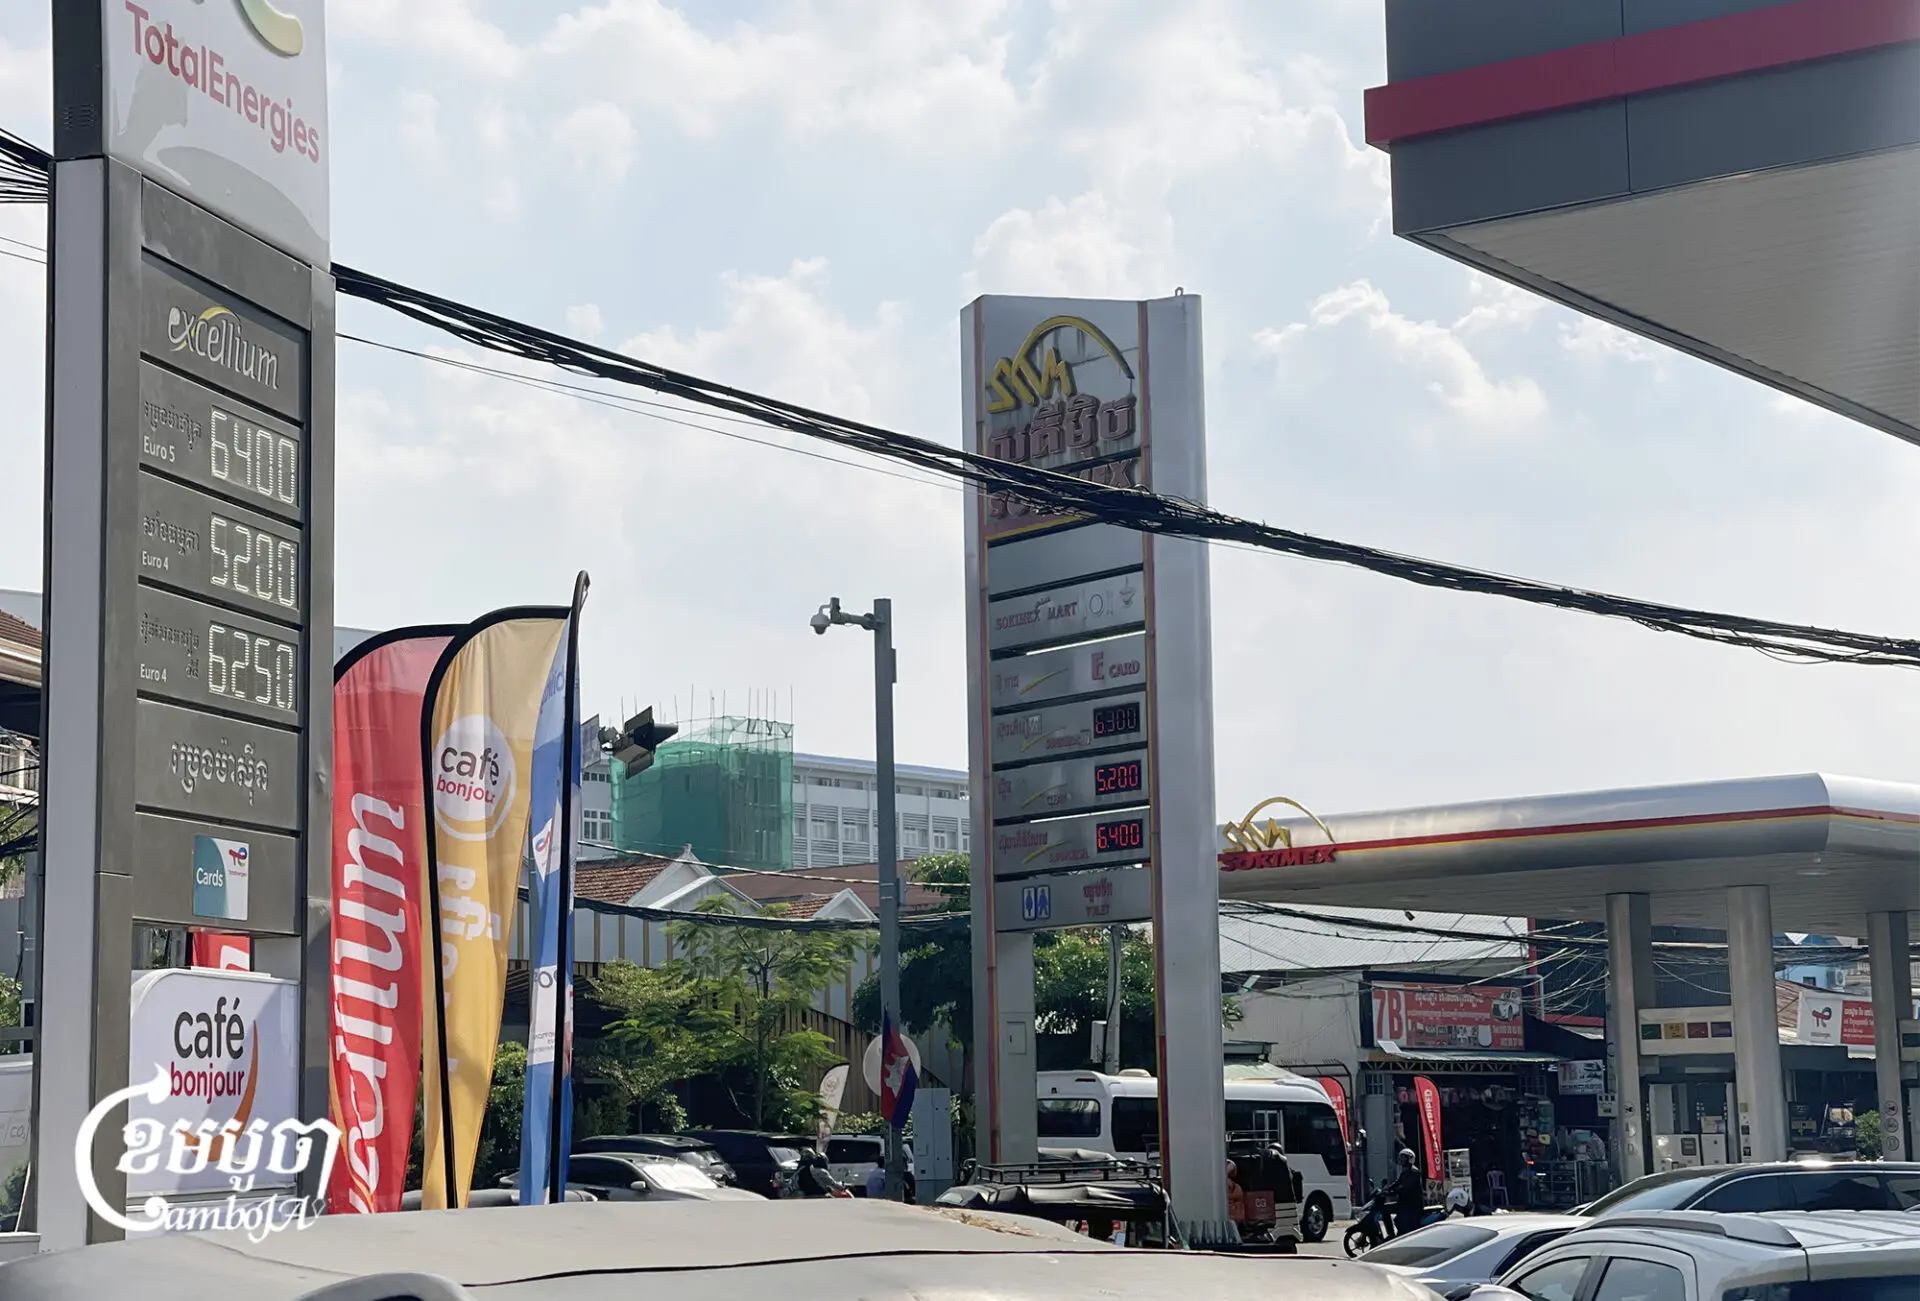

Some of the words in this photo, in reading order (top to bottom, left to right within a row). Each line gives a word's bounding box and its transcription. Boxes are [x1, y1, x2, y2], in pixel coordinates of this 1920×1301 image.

[125, 1, 320, 163] TotalEnergies
[168, 306, 280, 390] excellium
[143, 435, 168, 460] Euro
[169, 445, 176, 463] 5
[210, 410, 296, 505] 6400
[142, 550, 162, 569] Euro
[163, 556, 169, 571] 4
[210, 516, 296, 608] 5200
[995, 609, 1041, 631] SOKIMEX
[1047, 601, 1078, 620] MART
[140, 663, 161, 682] Euro
[161, 668, 168, 683] 4
[208, 623, 294, 710] 6250
[1091, 651, 1105, 681] E
[1108, 659, 1142, 679] CARD
[1094, 706, 1138, 735] 6.300
[440, 746, 500, 787] café
[1095, 764, 1139, 792] 5.200
[1096, 823, 1141, 850] 6.400
[1220, 847, 1337, 872] SOKIMEX
[196, 867, 224, 888] Cards
[174, 996, 245, 1060] café
[1373, 989, 1404, 1041] 7B
[170, 1061, 245, 1105] bonjour
